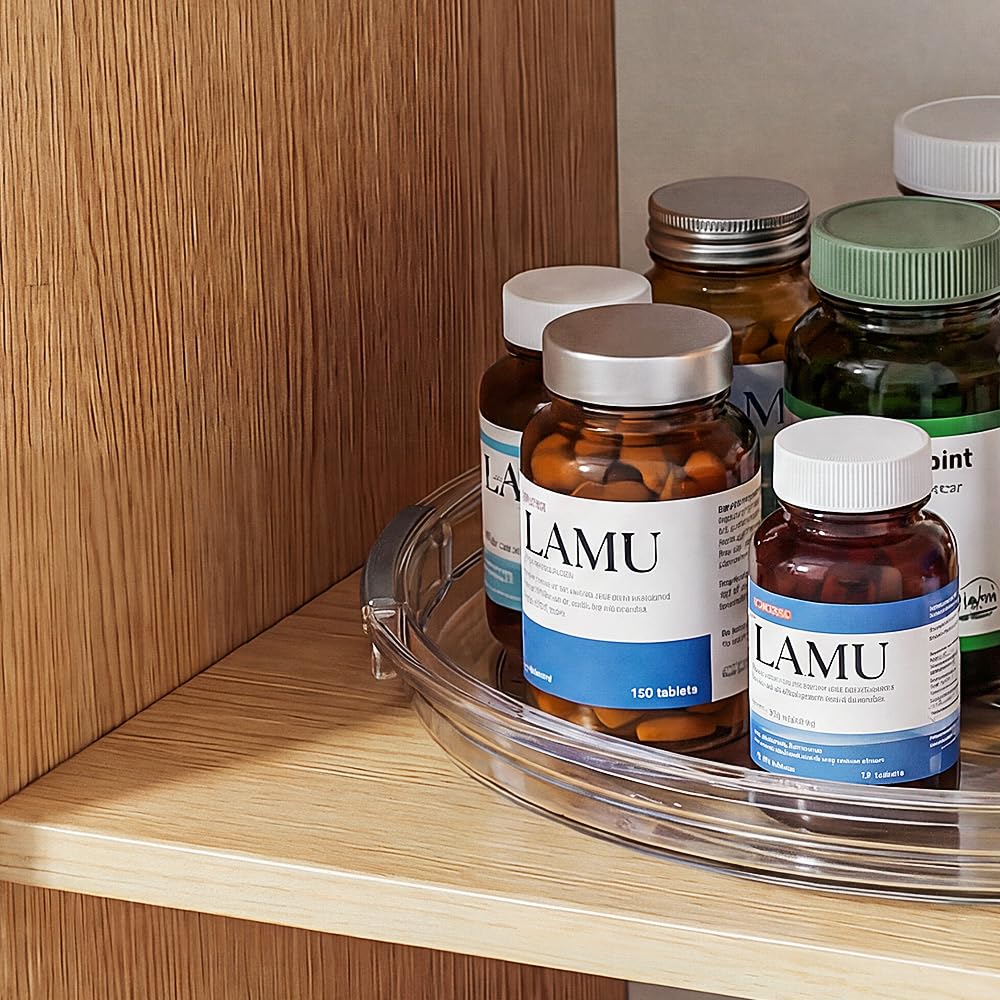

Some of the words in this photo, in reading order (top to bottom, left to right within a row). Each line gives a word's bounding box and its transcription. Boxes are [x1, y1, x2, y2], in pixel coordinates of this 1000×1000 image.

[524, 509, 661, 574] LAMU
[754, 623, 889, 680] LAMU
[630, 686, 654, 699] 150
